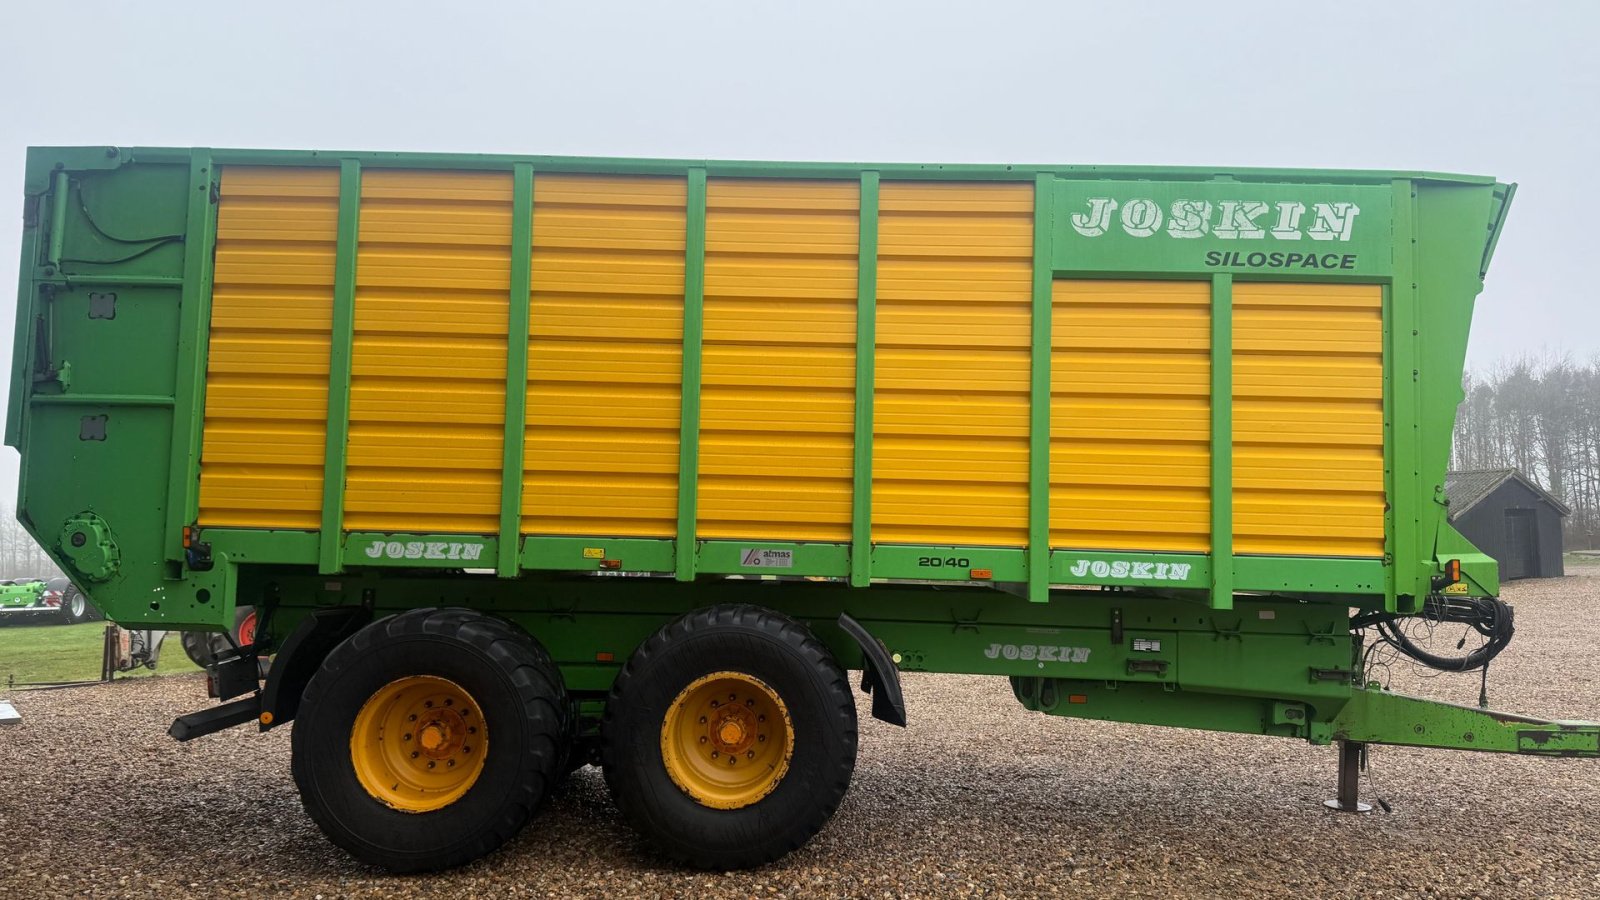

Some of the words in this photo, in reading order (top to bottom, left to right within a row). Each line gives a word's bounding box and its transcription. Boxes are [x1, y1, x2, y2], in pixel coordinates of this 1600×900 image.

[1070, 197, 1360, 241] JOSKIN
[1204, 251, 1357, 269] SILOSPACE
[366, 541, 483, 560] JOSKIN
[918, 556, 970, 568] 20/40
[1069, 559, 1191, 581] JOSKIN
[984, 643, 1091, 663] JOSKIN
